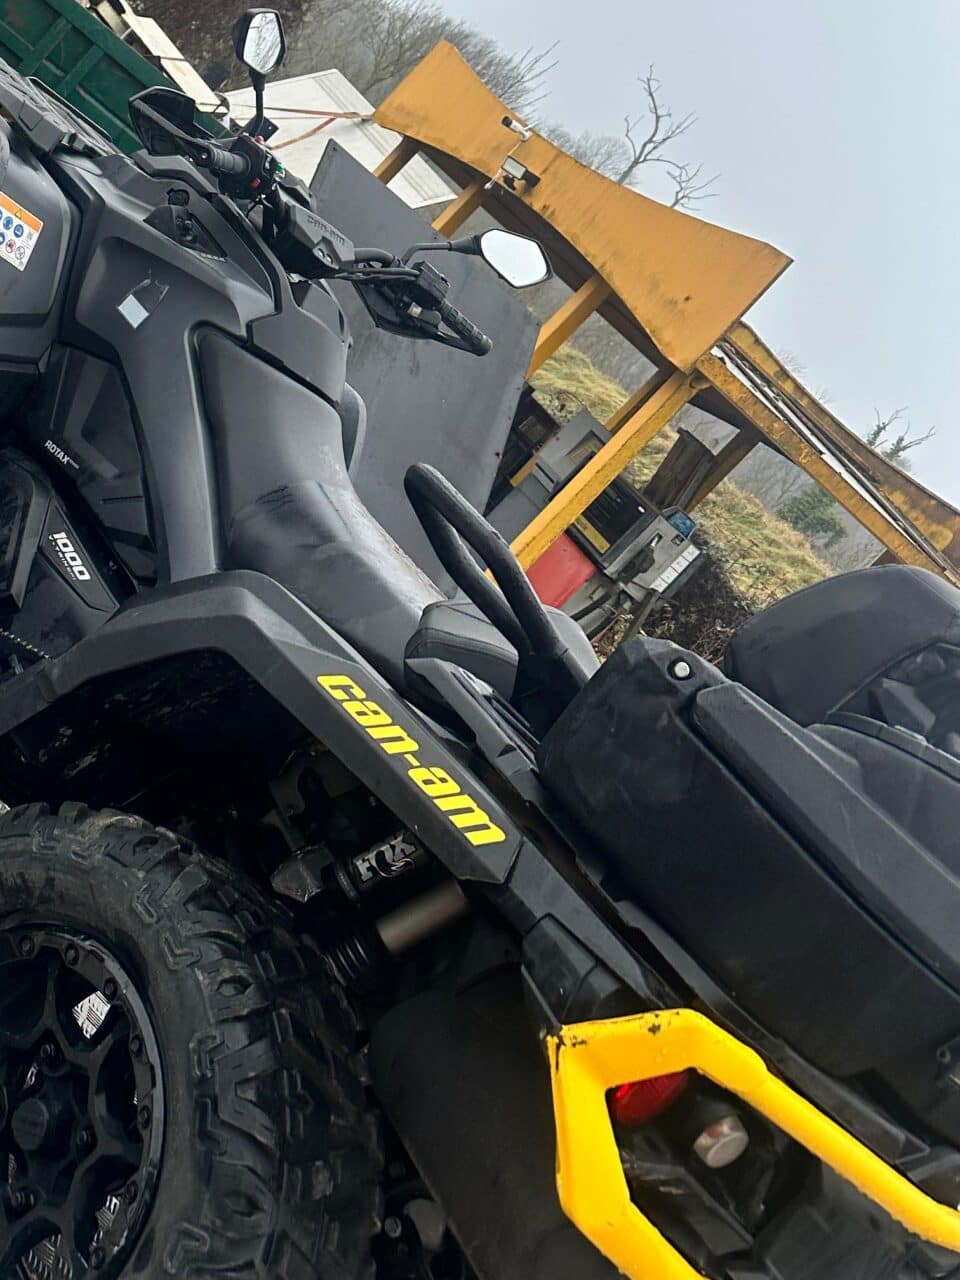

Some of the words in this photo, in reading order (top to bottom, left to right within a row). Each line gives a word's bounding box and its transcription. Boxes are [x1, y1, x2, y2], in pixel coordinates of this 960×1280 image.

[44, 440, 70, 465] ROTAX
[52, 531, 91, 580] 1000
[316, 674, 506, 847] can-am
[353, 833, 416, 881] FOX
